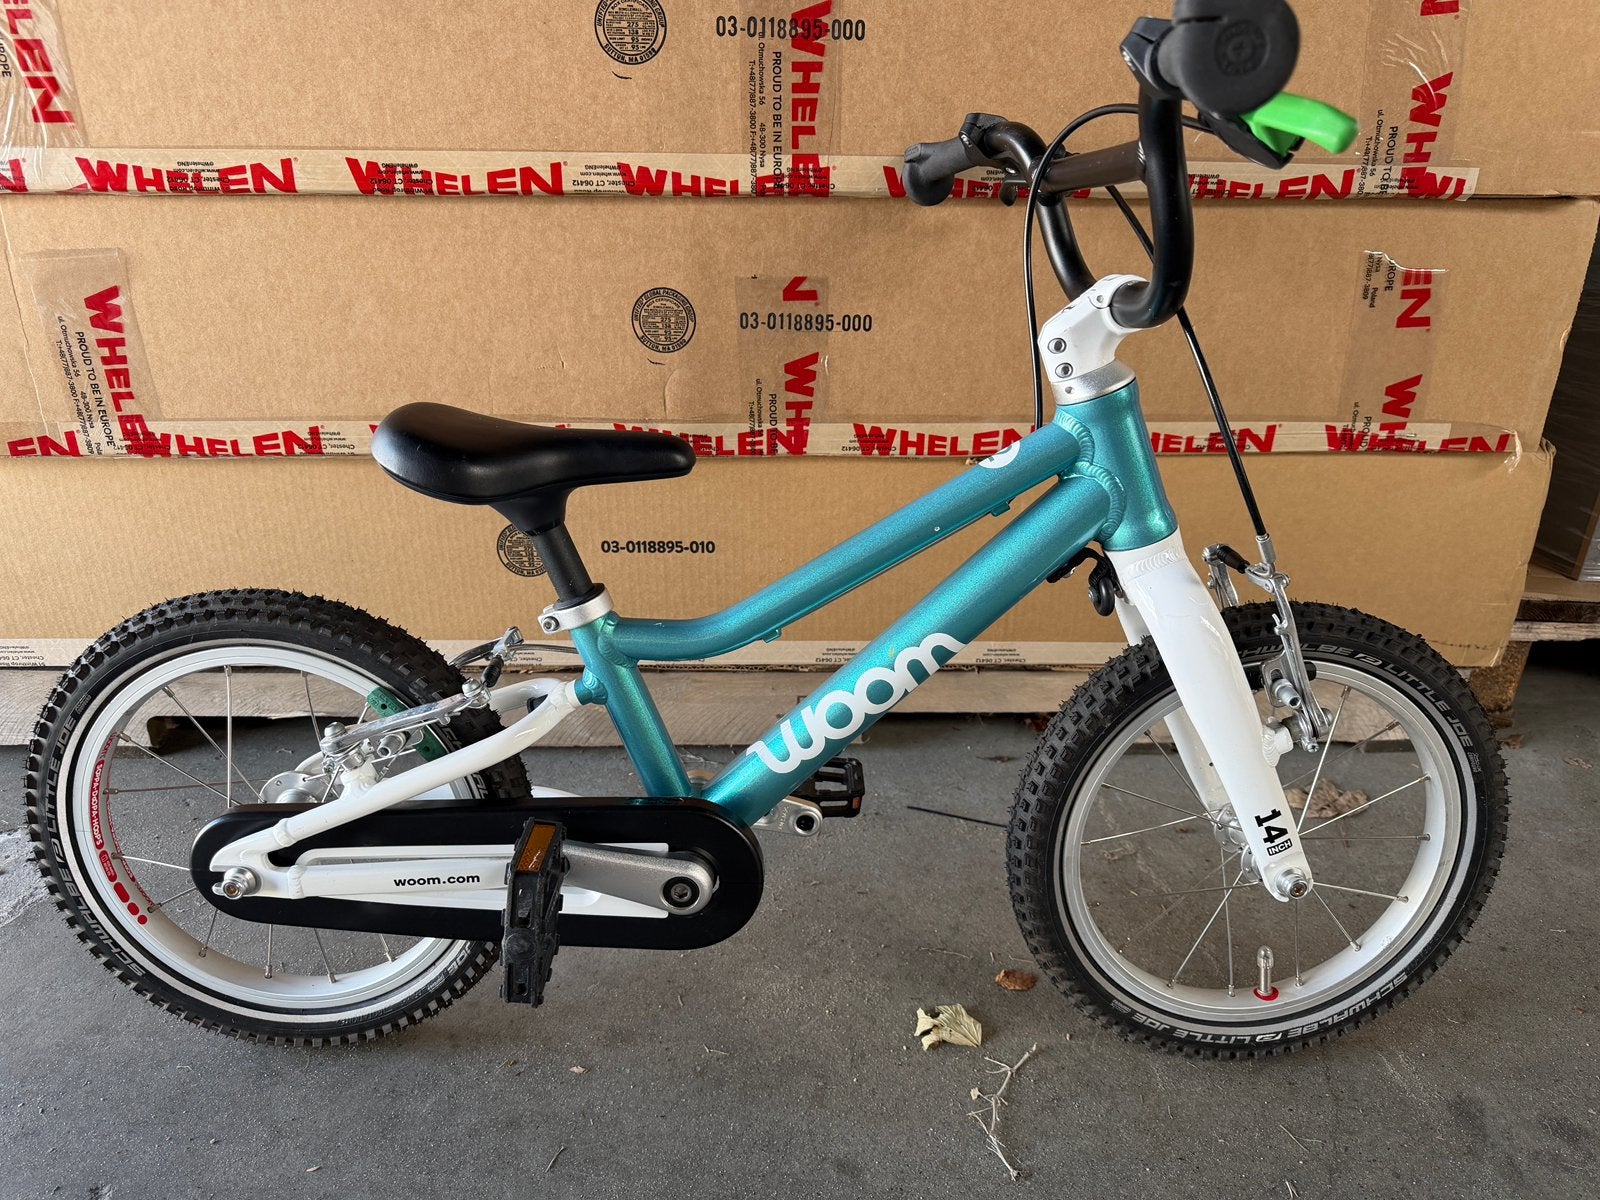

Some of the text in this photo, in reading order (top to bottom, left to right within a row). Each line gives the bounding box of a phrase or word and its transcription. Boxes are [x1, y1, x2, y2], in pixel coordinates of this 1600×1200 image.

[716, 16, 865, 41] 03-0118895-000
[758, 42, 766, 94] Otmuchowska
[772, 51, 782, 93] PROUD
[758, 96, 766, 105] 56
[772, 95, 782, 113] TO
[772, 114, 782, 128] BE
[772, 131, 782, 143] IN
[757, 150, 766, 168] Nysa
[1384, 126, 1399, 165] PROUD
[75, 157, 298, 193] WHELEN
[345, 157, 565, 196] WHELEN
[1190, 168, 1355, 200] HELEN
[739, 312, 873, 332] 03-0118895-000
[75, 331, 116, 447] PROUD TO BE IN EUROPE
[769, 393, 777, 426] PROUD
[601, 540, 716, 554] 03-0118895-010
[746, 632, 966, 774] woom
[1384, 663, 1450, 712] LITTLE
[1446, 715, 1473, 747] JOE
[56, 715, 77, 755] JOE
[46, 756, 61, 832] LITTLE
[1254, 808, 1289, 844] 14
[1268, 840, 1292, 855] INCH
[393, 874, 480, 887] woom.com
[60, 868, 147, 977] SCHWALBE
[1132, 971, 1408, 1044] SCHWALBE LITTLE JOE
